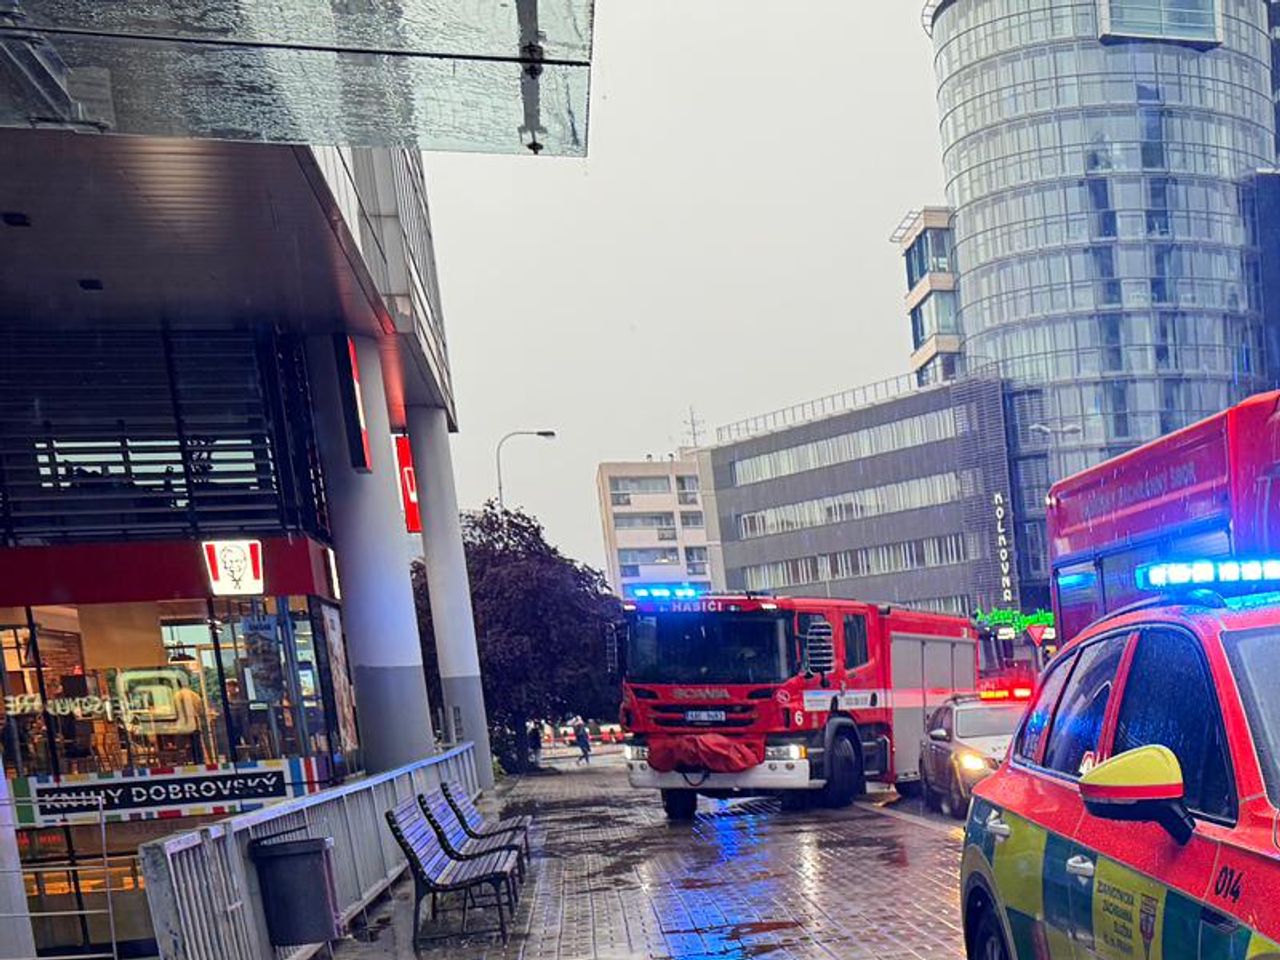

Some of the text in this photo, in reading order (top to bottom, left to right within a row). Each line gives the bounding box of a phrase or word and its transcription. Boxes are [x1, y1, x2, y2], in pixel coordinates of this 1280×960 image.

[994, 493, 1013, 602] KOLKOVNA
[795, 711, 804, 726] 6
[43, 776, 278, 810] KNIHY DOBROVSKÝ
[1215, 864, 1244, 904] 014
